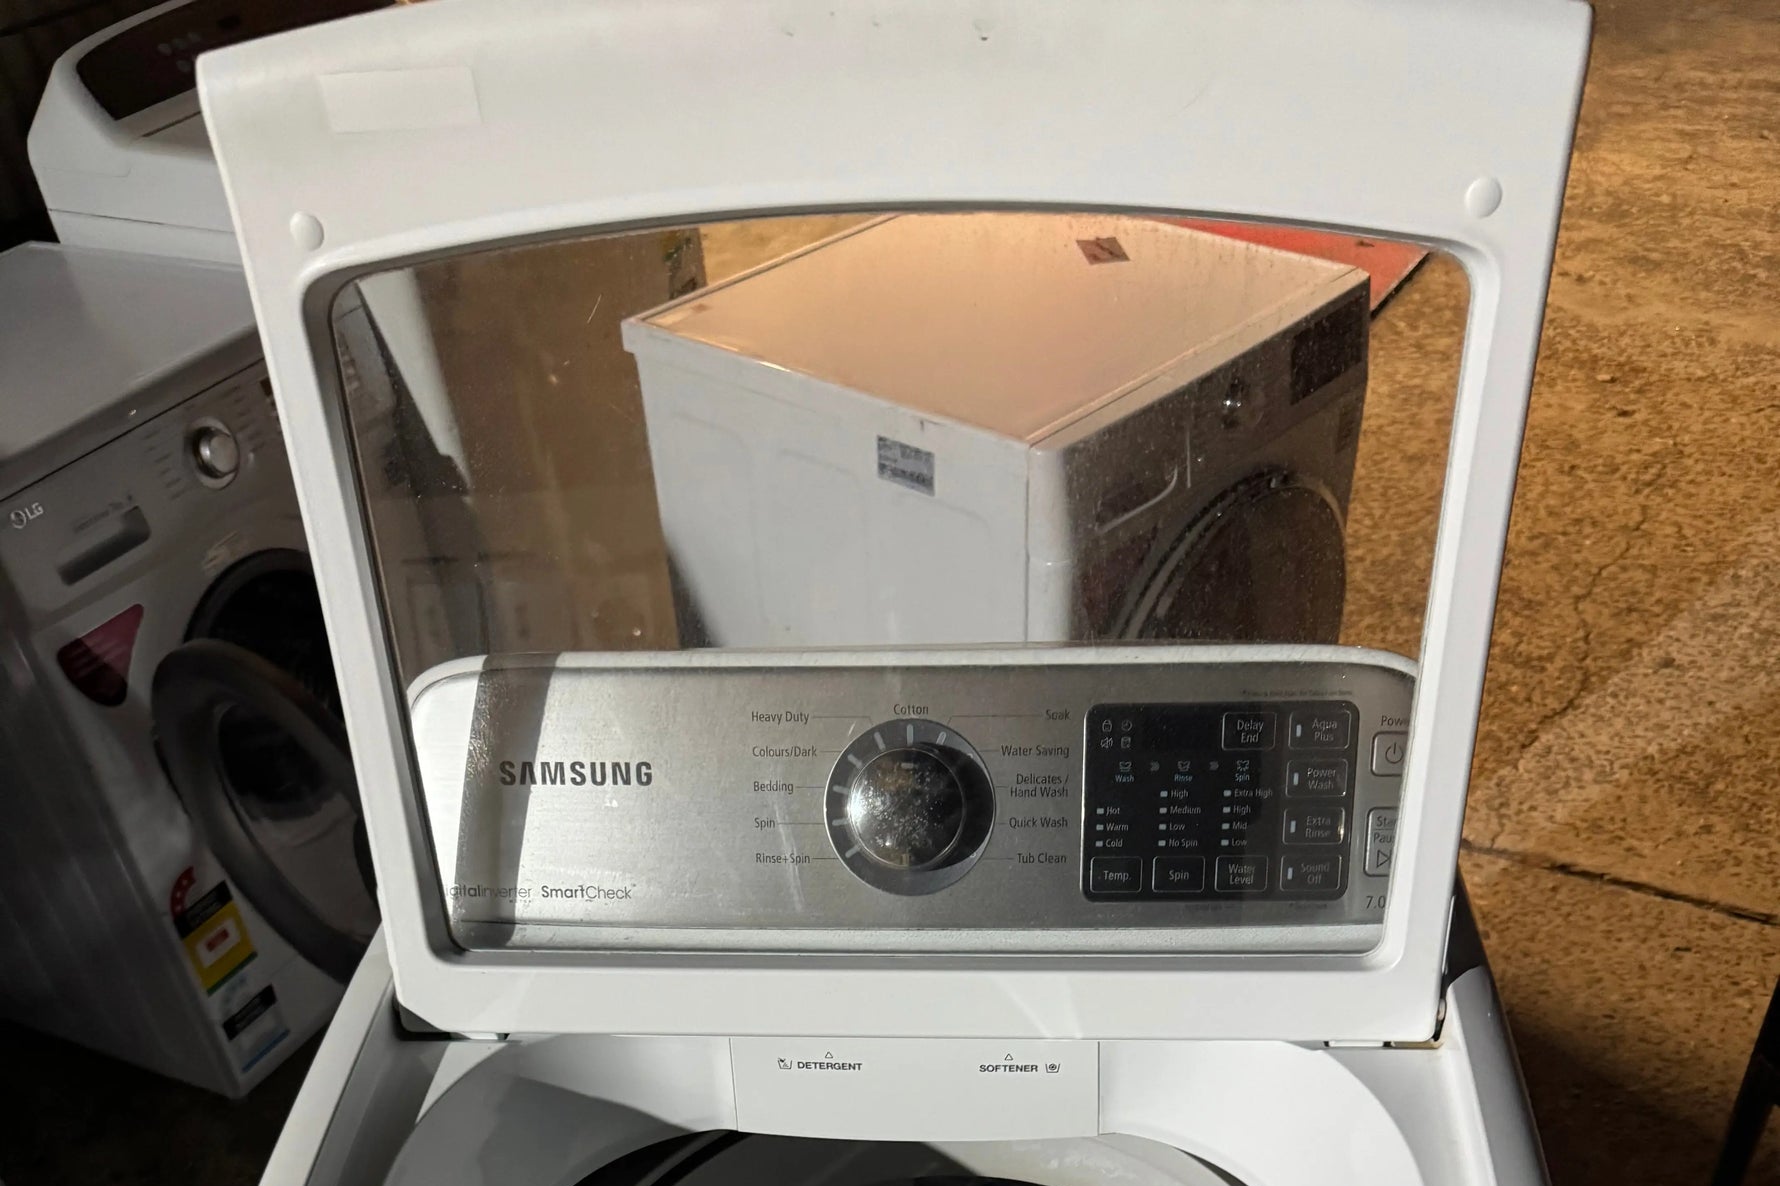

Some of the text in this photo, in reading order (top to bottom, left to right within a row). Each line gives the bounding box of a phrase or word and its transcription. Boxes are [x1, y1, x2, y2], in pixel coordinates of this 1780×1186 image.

[893, 703, 929, 715] Cotton
[1046, 709, 1071, 720] Soak
[751, 711, 810, 725] Heavy Duty
[1236, 719, 1264, 733] Delay
[1312, 719, 1338, 731] Aqua
[1241, 733, 1259, 743] End
[1314, 731, 1334, 741] Plus
[752, 745, 817, 758] Colours/Dark
[1001, 744, 1070, 759] Water Saving
[499, 761, 653, 787] SAMSUNG
[1174, 773, 1193, 782] Rinse
[1235, 773, 1250, 783] Spin
[1307, 767, 1336, 778] Power
[1016, 773, 1063, 785] Delicates
[1115, 774, 1135, 783] Wash
[753, 780, 794, 795] Bedding
[1308, 780, 1334, 790] Wash
[1010, 787, 1069, 798] Hand Wash
[1171, 789, 1189, 799] High
[1234, 789, 1273, 799] Extra High
[1106, 806, 1121, 816] Hot
[1170, 805, 1202, 814] Medium
[1233, 804, 1251, 815] High
[754, 817, 776, 830] Spin
[1009, 816, 1069, 829] Quick Wash
[1232, 821, 1248, 830] Mid
[1306, 815, 1331, 826] Extra
[1106, 822, 1129, 832] Warm
[1169, 822, 1186, 831] Low
[1305, 828, 1331, 839] Rinse
[1105, 838, 1123, 848] Cold
[1168, 839, 1199, 849] No Spin
[1231, 838, 1248, 847] Low
[755, 852, 811, 867] Rinse+Spin
[1017, 852, 1067, 864] Tub Clean
[1228, 863, 1256, 874] Water
[1301, 862, 1330, 873] Sound
[1103, 870, 1132, 883] Temp.
[1169, 870, 1190, 883] Spin
[1229, 874, 1254, 885] Level
[1307, 873, 1323, 885] Off
[541, 885, 632, 899] SmartCheck
[796, 1061, 863, 1072] DETERGENT
[978, 1063, 1039, 1074] SOFTENER
